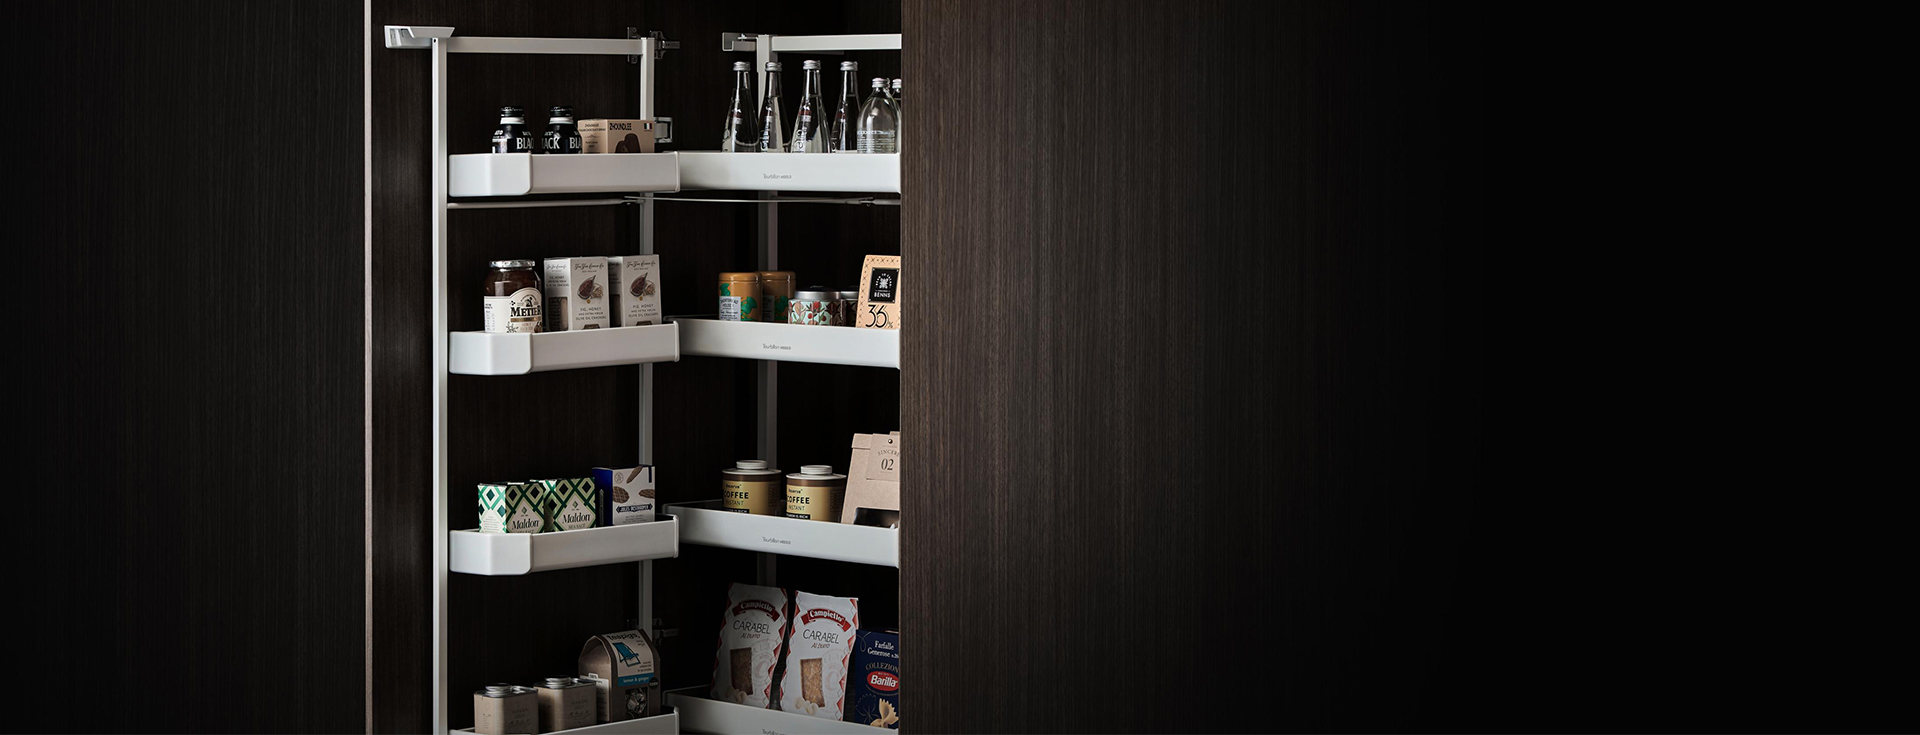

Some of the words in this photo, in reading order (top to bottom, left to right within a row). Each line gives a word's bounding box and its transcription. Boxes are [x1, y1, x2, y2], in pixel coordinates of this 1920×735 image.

[881, 457, 894, 471] 02
[724, 491, 749, 500] COFFEE
[512, 518, 539, 530] Maldon
[563, 513, 591, 524] Maldon
[733, 620, 771, 634] CARABEL
[802, 629, 840, 644] CARABEL
[870, 674, 897, 688] Barilla
